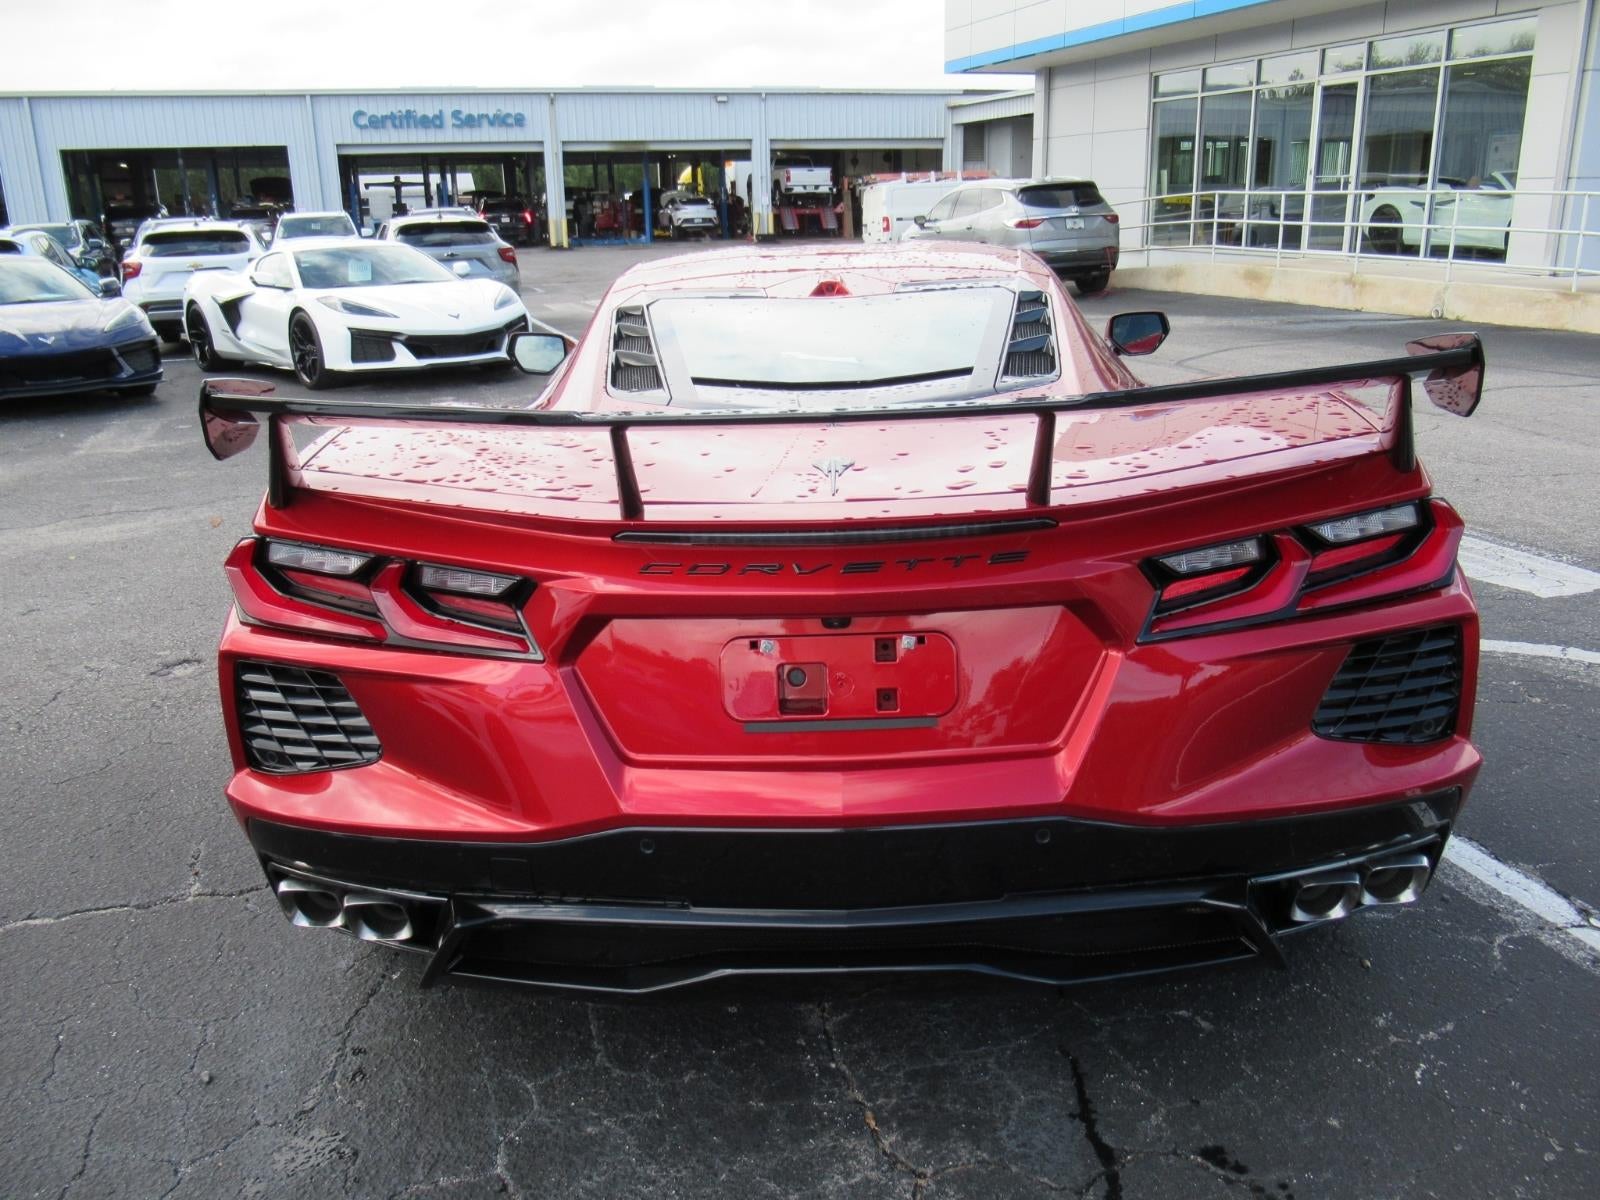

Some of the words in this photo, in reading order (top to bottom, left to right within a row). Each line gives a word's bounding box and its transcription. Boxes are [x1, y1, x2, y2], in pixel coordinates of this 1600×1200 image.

[352, 109, 445, 129] Certified
[451, 108, 526, 129] Service
[638, 550, 1032, 576] CORVETTE
